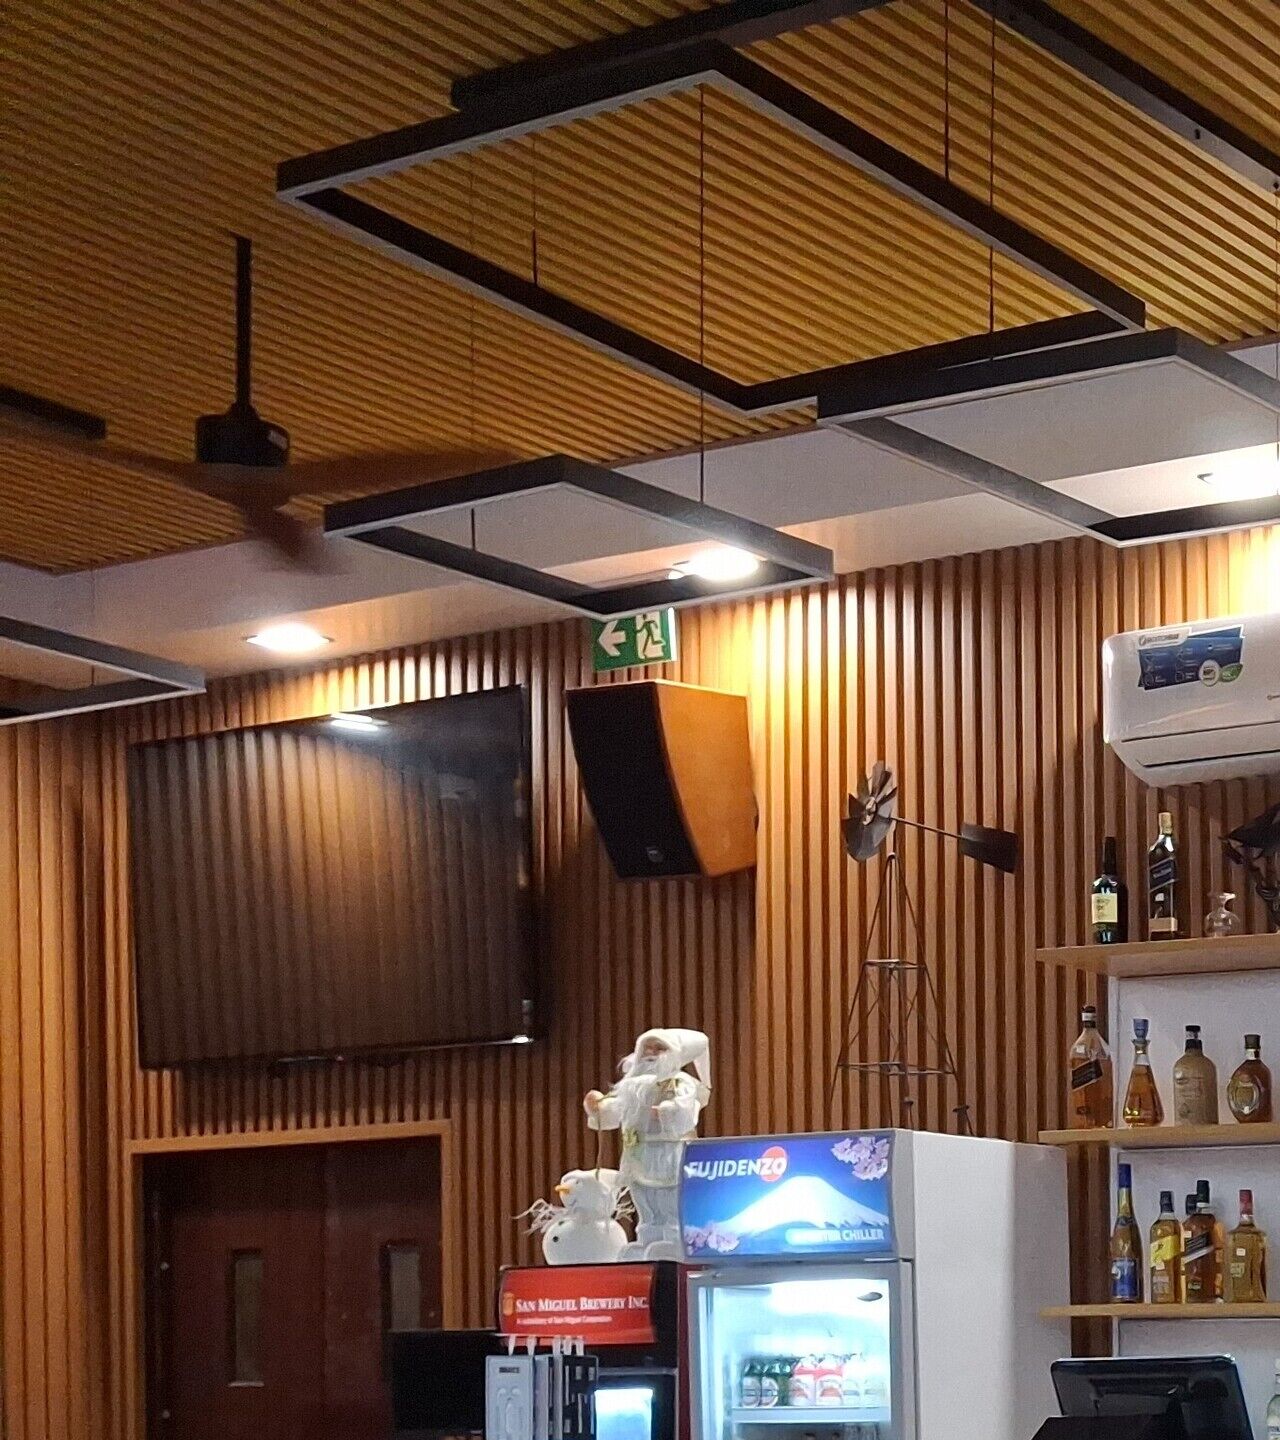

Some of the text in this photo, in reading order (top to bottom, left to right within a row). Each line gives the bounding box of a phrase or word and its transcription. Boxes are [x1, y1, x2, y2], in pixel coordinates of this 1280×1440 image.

[516, 1299, 536, 1313] SAN
[538, 1297, 578, 1312] MIGUEL
[580, 1296, 626, 1311] BREWERY
